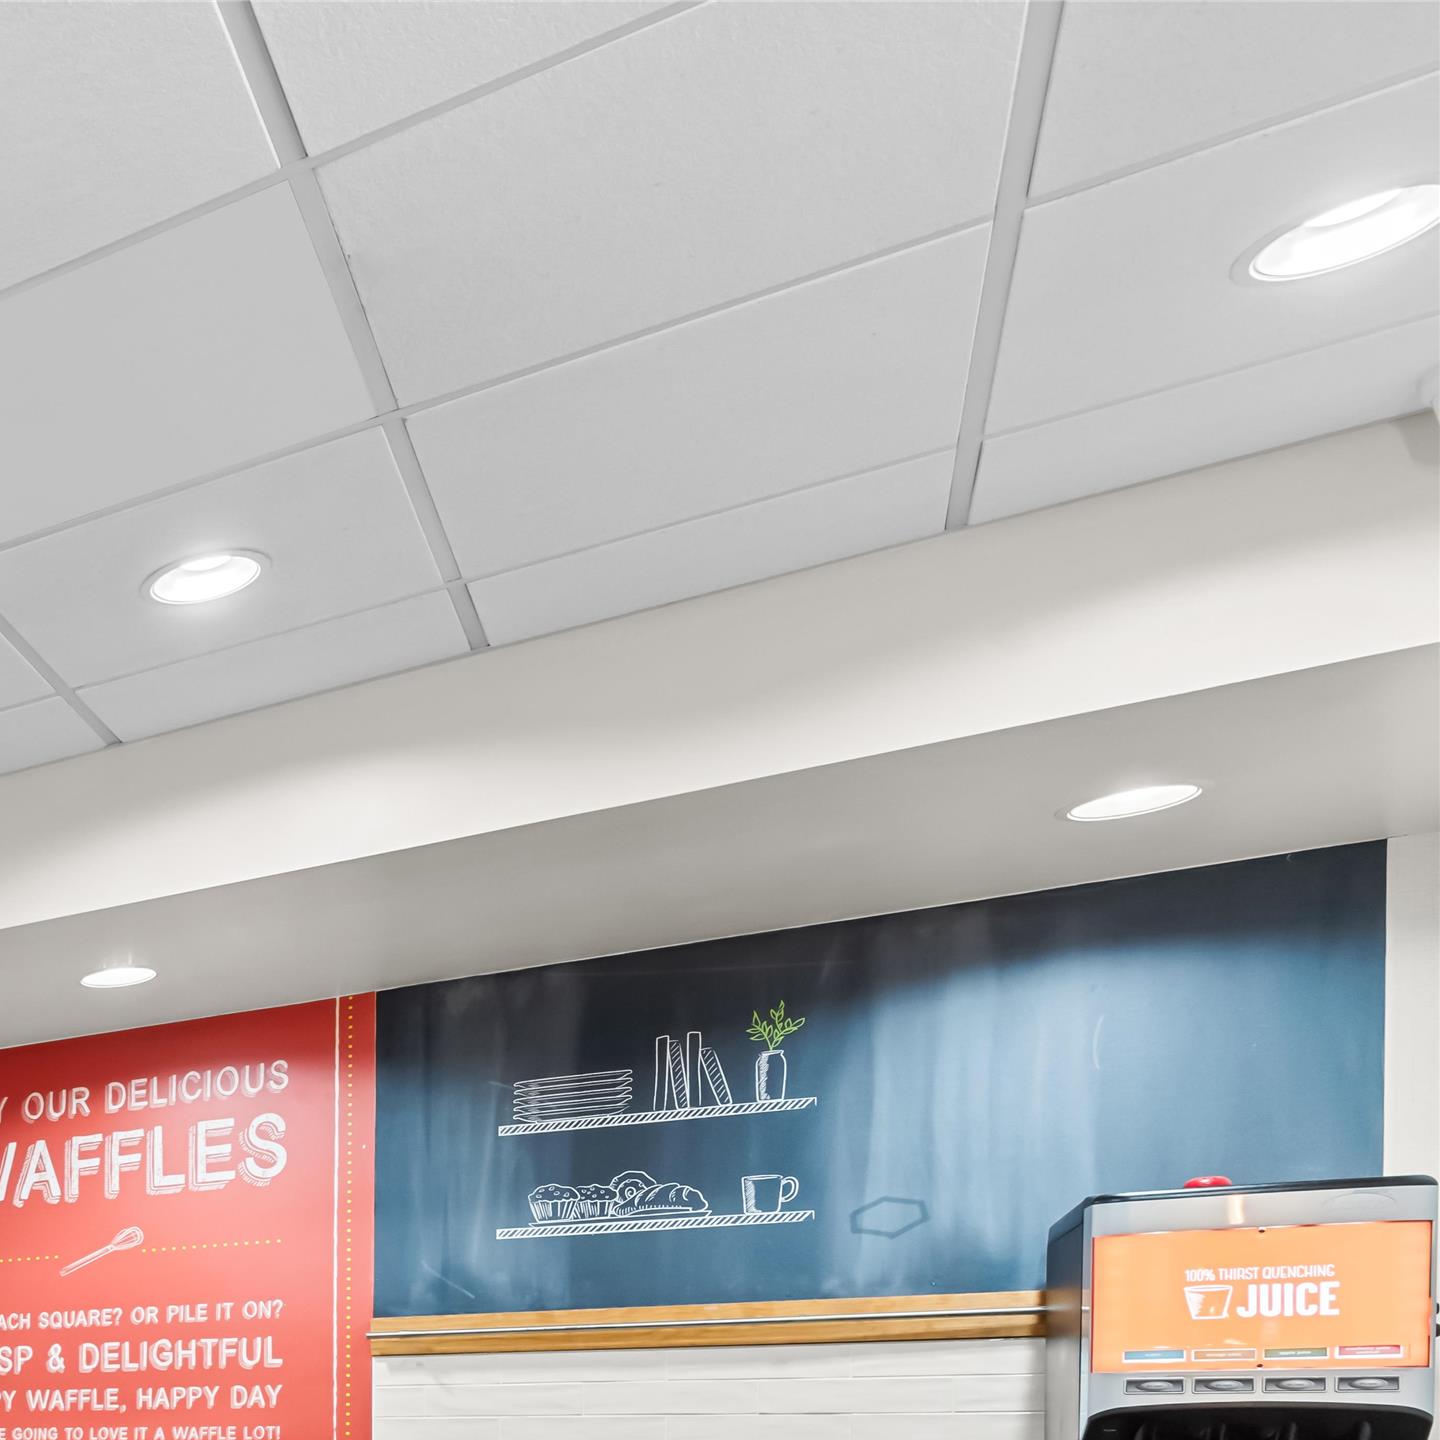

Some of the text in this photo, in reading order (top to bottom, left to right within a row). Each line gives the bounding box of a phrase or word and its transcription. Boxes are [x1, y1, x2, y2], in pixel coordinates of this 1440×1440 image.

[22, 1086, 91, 1124] OUR
[104, 1059, 290, 1114] DELICIOUS
[1185, 1264, 1335, 1282] 100% THIRST QUENCHING
[38, 1308, 123, 1330] SQUARE?
[130, 1306, 159, 1325] OR
[166, 1303, 209, 1324] PILE
[215, 1302, 234, 1321] IT
[242, 1299, 283, 1320] ON?
[1236, 1280, 1340, 1318] JUICE
[47, 1343, 66, 1374] &
[79, 1336, 283, 1373] DELIGHTFUL
[26, 1388, 127, 1413] WAFFLE,
[136, 1385, 220, 1410] HAPPY
[230, 1384, 283, 1409] DAY
[11, 1427, 58, 1440] GOING
[64, 1427, 84, 1440] TO
[89, 1427, 128, 1440] LOVE
[133, 1426, 148, 1440] IT
[153, 1426, 165, 1440] A
[172, 1426, 237, 1440] WAFFLE
[243, 1425, 281, 1440] LOT!
